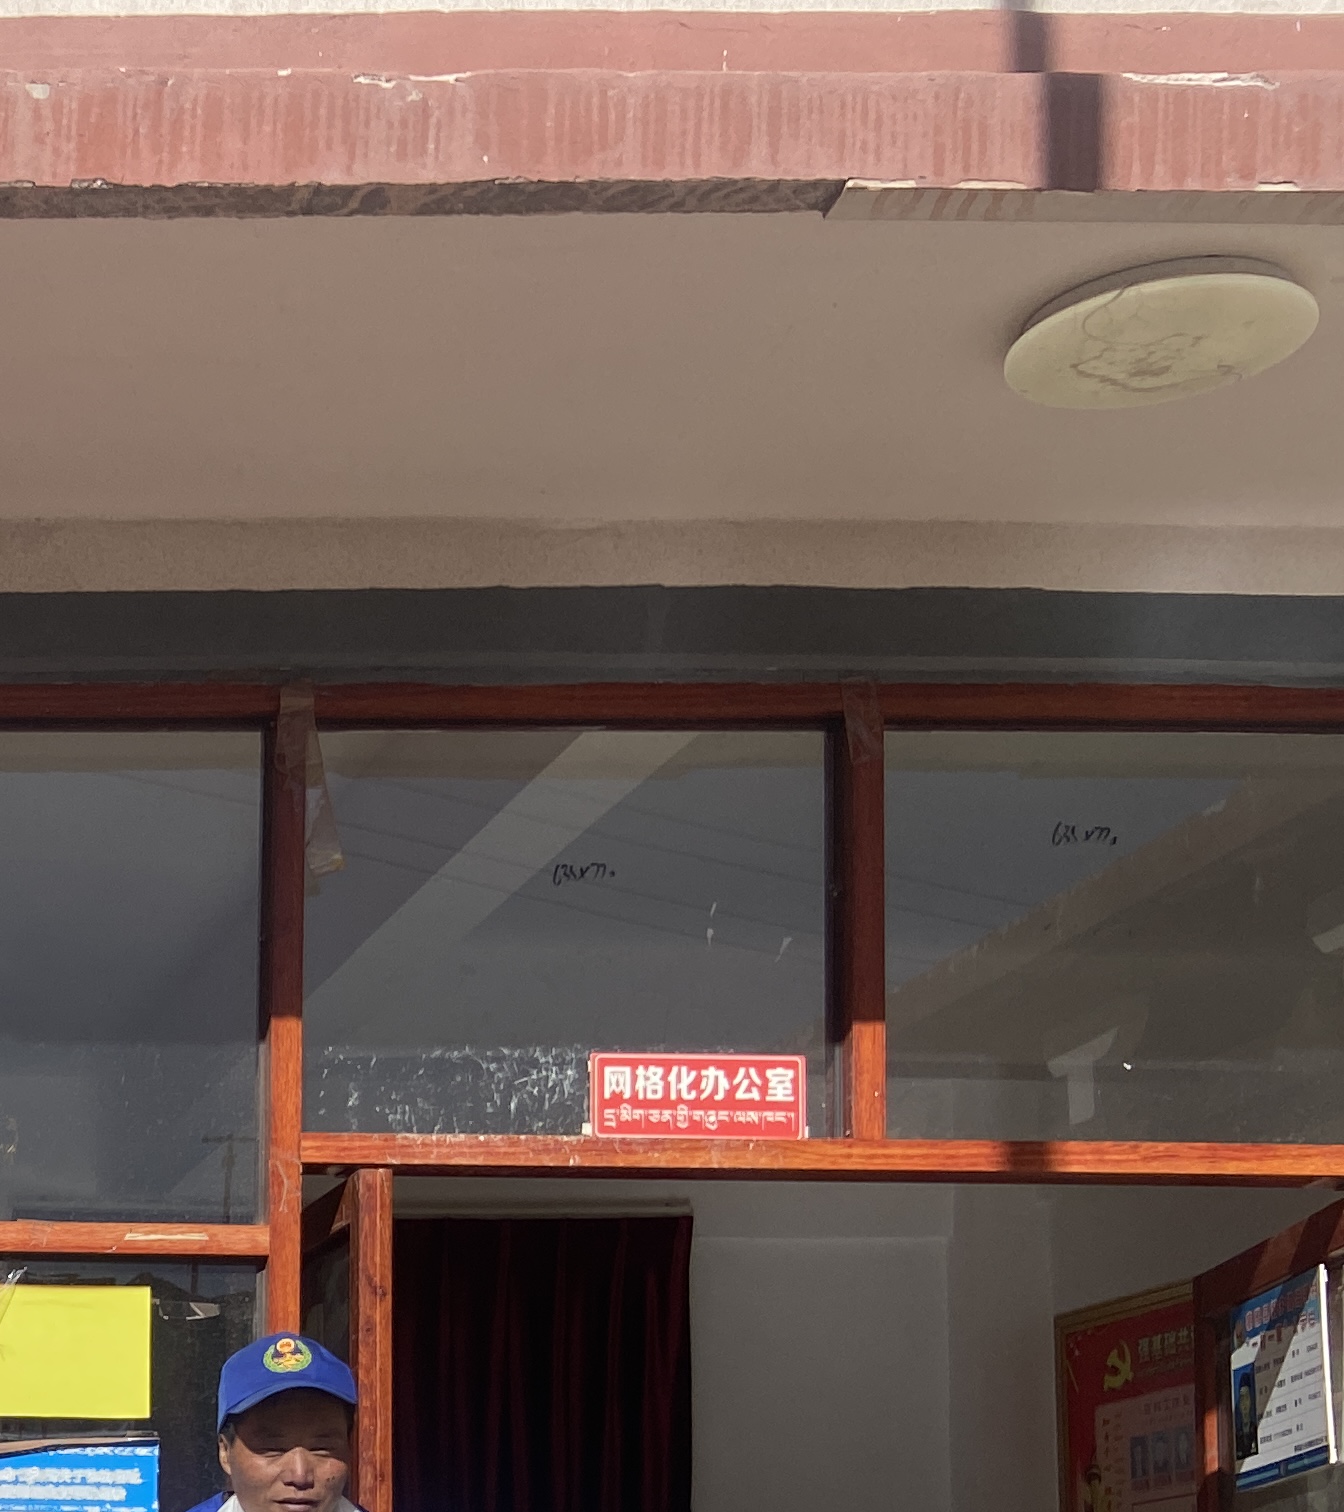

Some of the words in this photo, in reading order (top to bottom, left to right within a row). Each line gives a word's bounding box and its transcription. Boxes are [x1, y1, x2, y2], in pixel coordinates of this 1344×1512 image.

[604, 1065, 795, 1102] 网格化办公室
